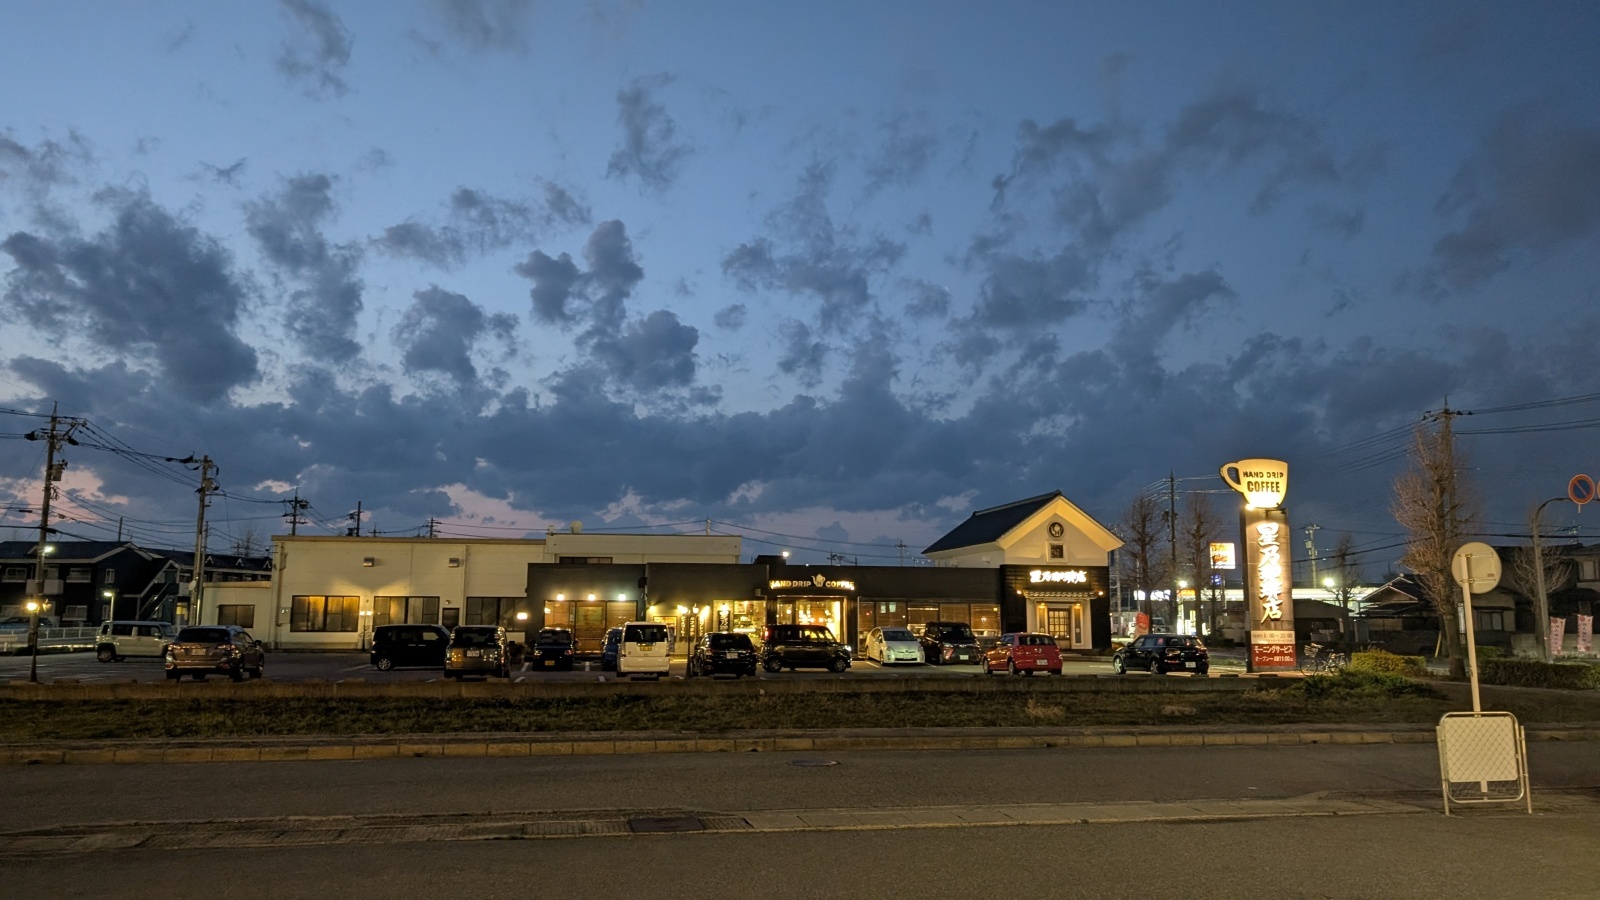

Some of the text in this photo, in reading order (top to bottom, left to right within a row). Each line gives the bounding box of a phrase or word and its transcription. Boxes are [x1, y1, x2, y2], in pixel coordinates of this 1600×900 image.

[1247, 481, 1280, 493] COFFEE
[769, 580, 855, 588] HAND DRIP COFFEE
[1254, 645, 1294, 654] モーニングサービス
